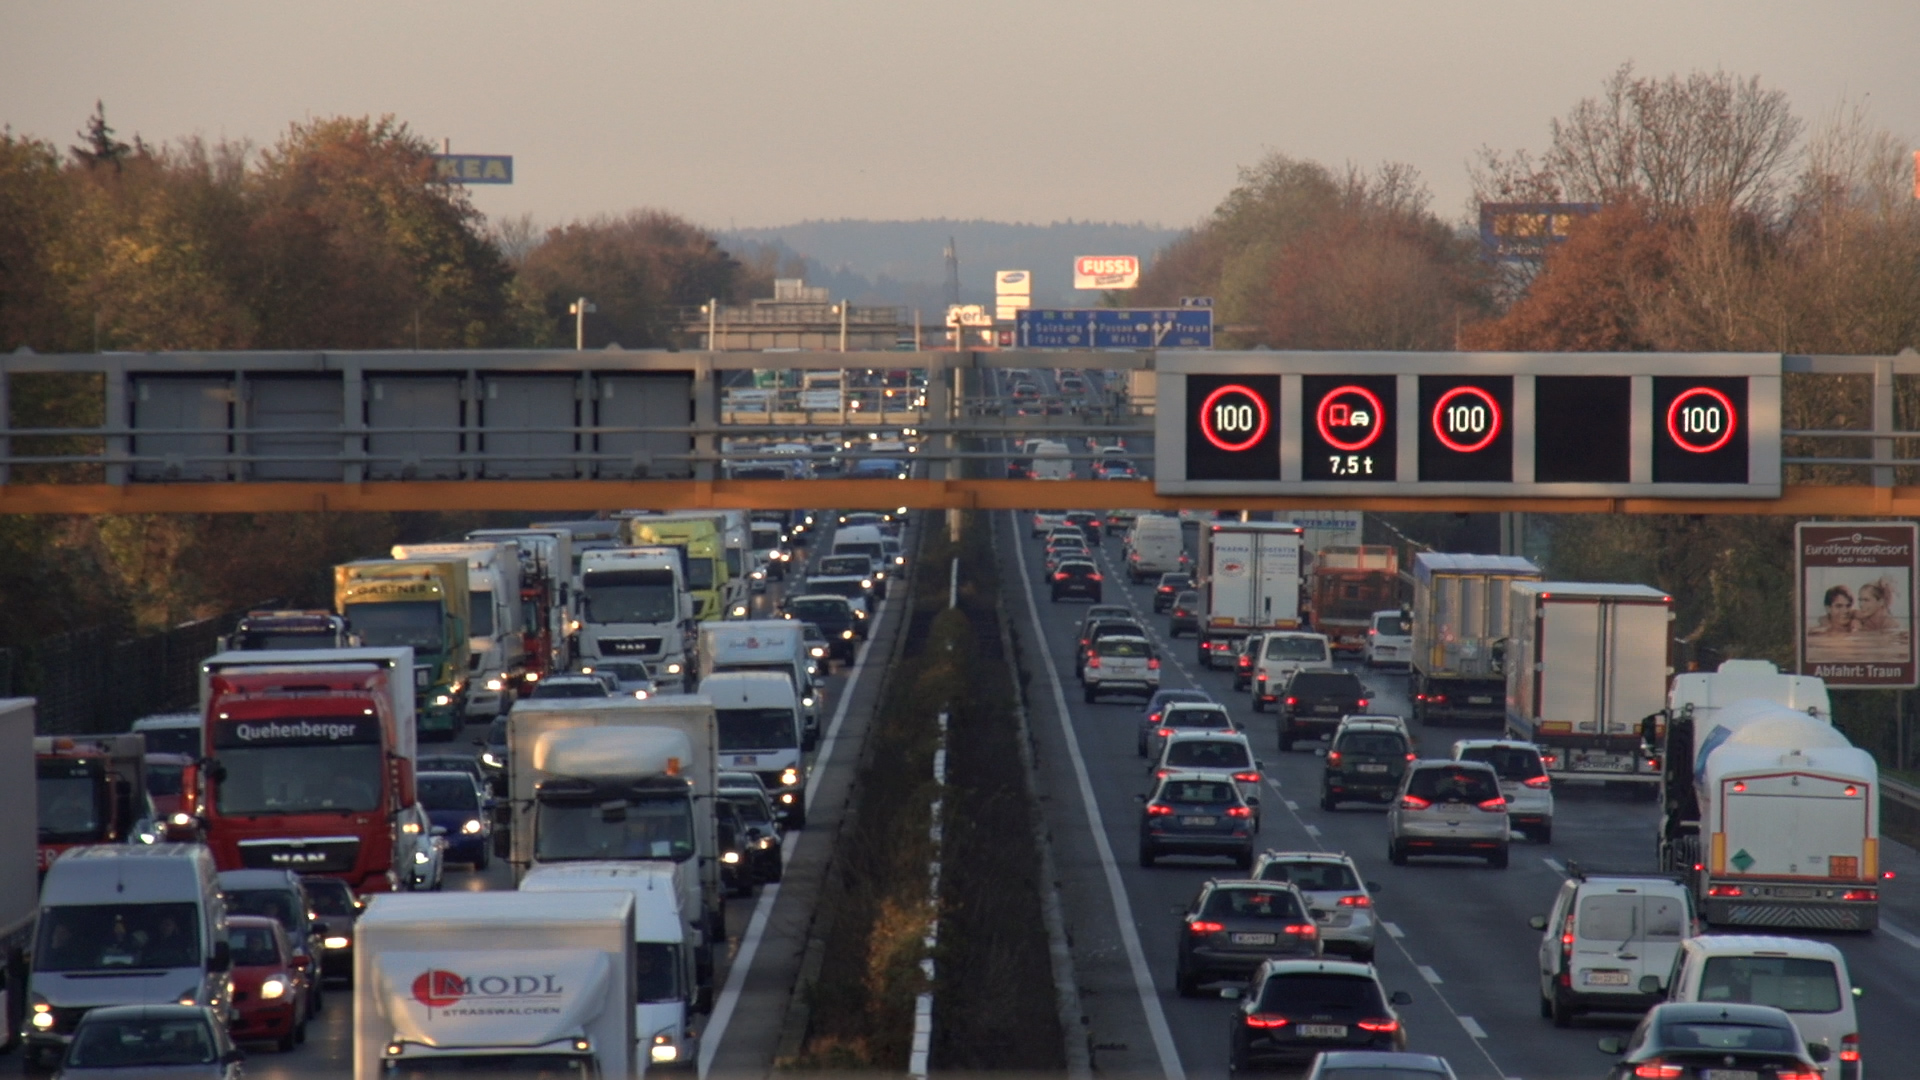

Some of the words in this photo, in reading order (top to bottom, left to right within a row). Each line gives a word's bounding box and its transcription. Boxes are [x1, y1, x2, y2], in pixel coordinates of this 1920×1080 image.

[1083, 259, 1132, 274] FUSSL
[1036, 322, 1082, 334] Salzburg
[1176, 323, 1209, 332] Traun
[1111, 334, 1137, 344] Wels
[1215, 404, 1252, 432] 100
[1447, 406, 1485, 433] 100
[1682, 407, 1720, 433] 100
[1329, 455, 1359, 475] 7,5
[1363, 455, 1373, 474] t
[1805, 544, 1909, 556] EurothermenResort
[1814, 665, 1864, 677] Abfahrt:
[1866, 665, 1902, 677] Traun
[236, 721, 356, 741] Quehenberger
[271, 852, 327, 862] MAN
[441, 974, 563, 996] MODL
[443, 1007, 561, 1017] STRASSWALCHEN
